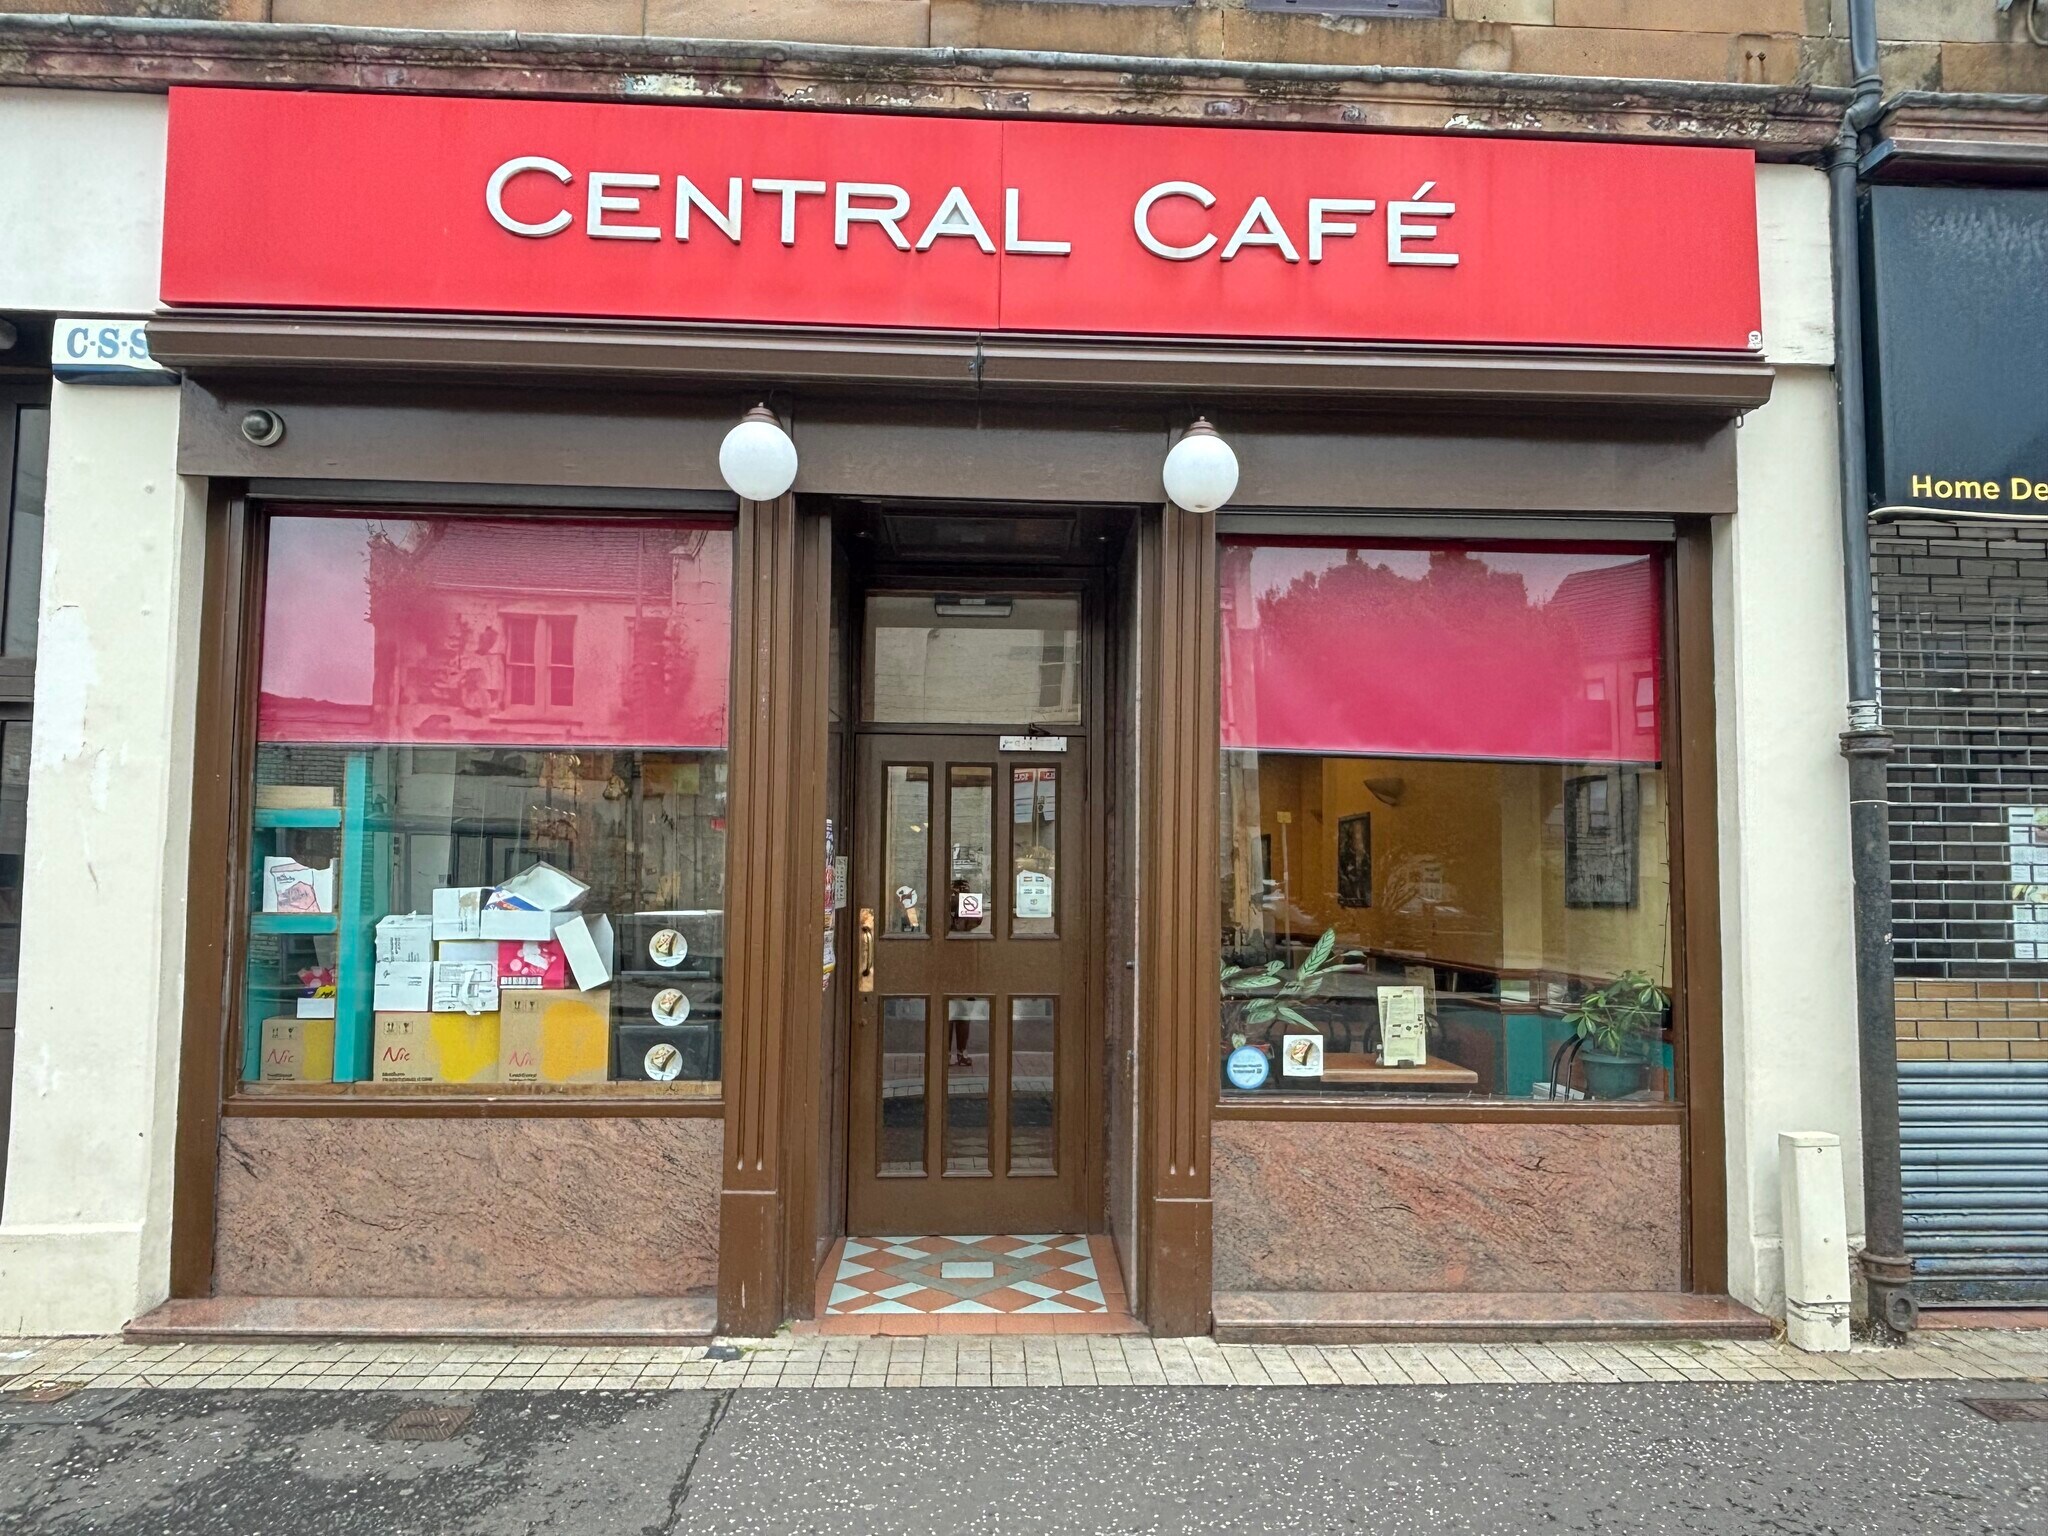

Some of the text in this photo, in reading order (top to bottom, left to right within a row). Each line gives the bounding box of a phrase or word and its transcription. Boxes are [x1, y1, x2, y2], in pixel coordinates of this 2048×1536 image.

[485, 156, 1460, 267] CENTRAL CAFÉ
[1912, 474, 2048, 501] Home De
